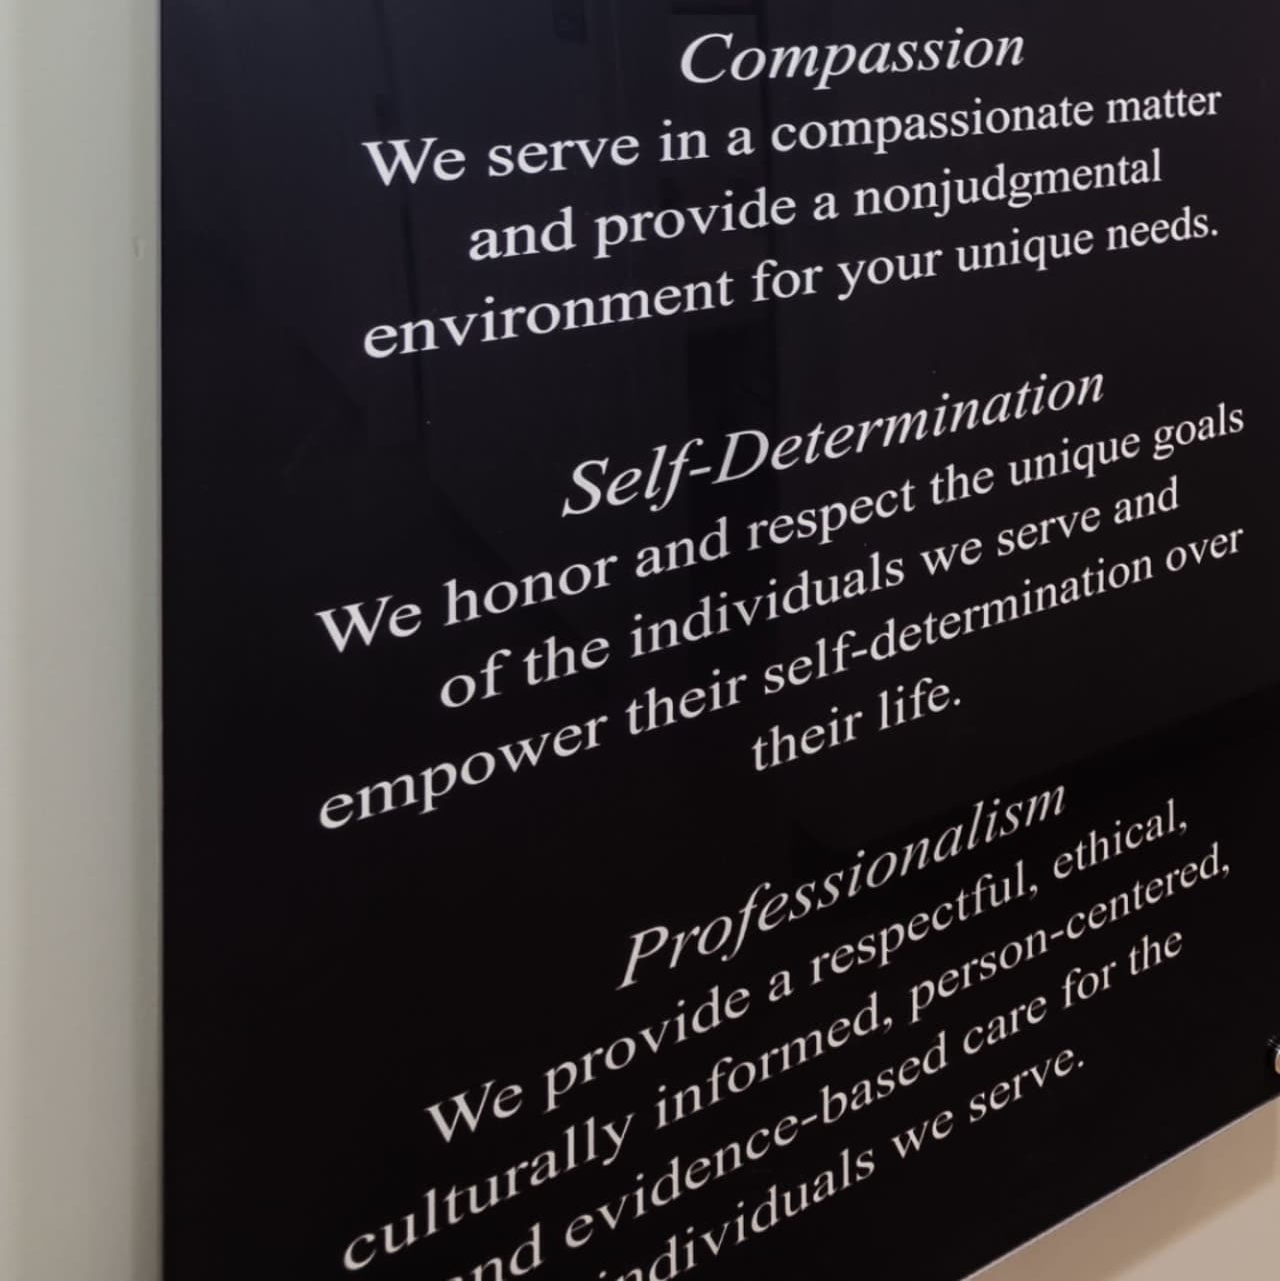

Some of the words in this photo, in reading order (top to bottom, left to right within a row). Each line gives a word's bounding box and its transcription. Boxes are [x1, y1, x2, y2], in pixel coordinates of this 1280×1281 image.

[361, 137, 466, 187] We
[488, 135, 640, 177] serve
[659, 118, 710, 162] in
[727, 126, 755, 156] a
[771, 96, 1094, 155] compassionate
[1106, 88, 1223, 124] matter
[680, 26, 1024, 91] Compassion
[363, 271, 735, 359] environment
[751, 259, 824, 302] for
[837, 249, 944, 302] your
[955, 227, 1094, 273] unique
[1106, 205, 1218, 251] needs.
[468, 205, 577, 261] and
[593, 186, 797, 260] provide
[813, 192, 840, 221] a
[853, 147, 1162, 218] nonjudgmental
[315, 595, 422, 653] We
[443, 555, 619, 626] honor
[635, 516, 730, 578] and
[747, 479, 916, 551] respect
[929, 463, 994, 505] the
[1008, 433, 1141, 486] unique
[1152, 402, 1244, 461] goals
[561, 372, 1104, 518] Self-Determination
[319, 715, 609, 829] empower
[625, 668, 748, 736] their
[764, 555, 1153, 695] self-determination
[1165, 528, 1244, 572] over
[440, 648, 512, 708] of
[522, 635, 610, 686] the
[631, 551, 905, 658] individuals
[919, 538, 983, 576] we
[997, 506, 1101, 557] serve
[1113, 474, 1179, 525] and
[752, 706, 863, 771] their
[879, 677, 961, 730] life.
[426, 1081, 523, 1142] We
[545, 985, 750, 1112] provide
[768, 970, 793, 1002] a
[811, 859, 1038, 985] respectful,
[1053, 798, 1187, 879] ethical,
[619, 785, 1065, 989] Professionalism
[343, 1114, 633, 1271] culturally
[657, 991, 893, 1128] informed,
[911, 841, 1230, 1024] person-centered,
[565, 1030, 947, 1248] evidence-based
[963, 996, 1047, 1055] care
[1062, 965, 1110, 1008] for
[1129, 932, 1182, 976] the
[891, 1110, 953, 1158] we
[969, 1049, 1086, 1118] serve.
